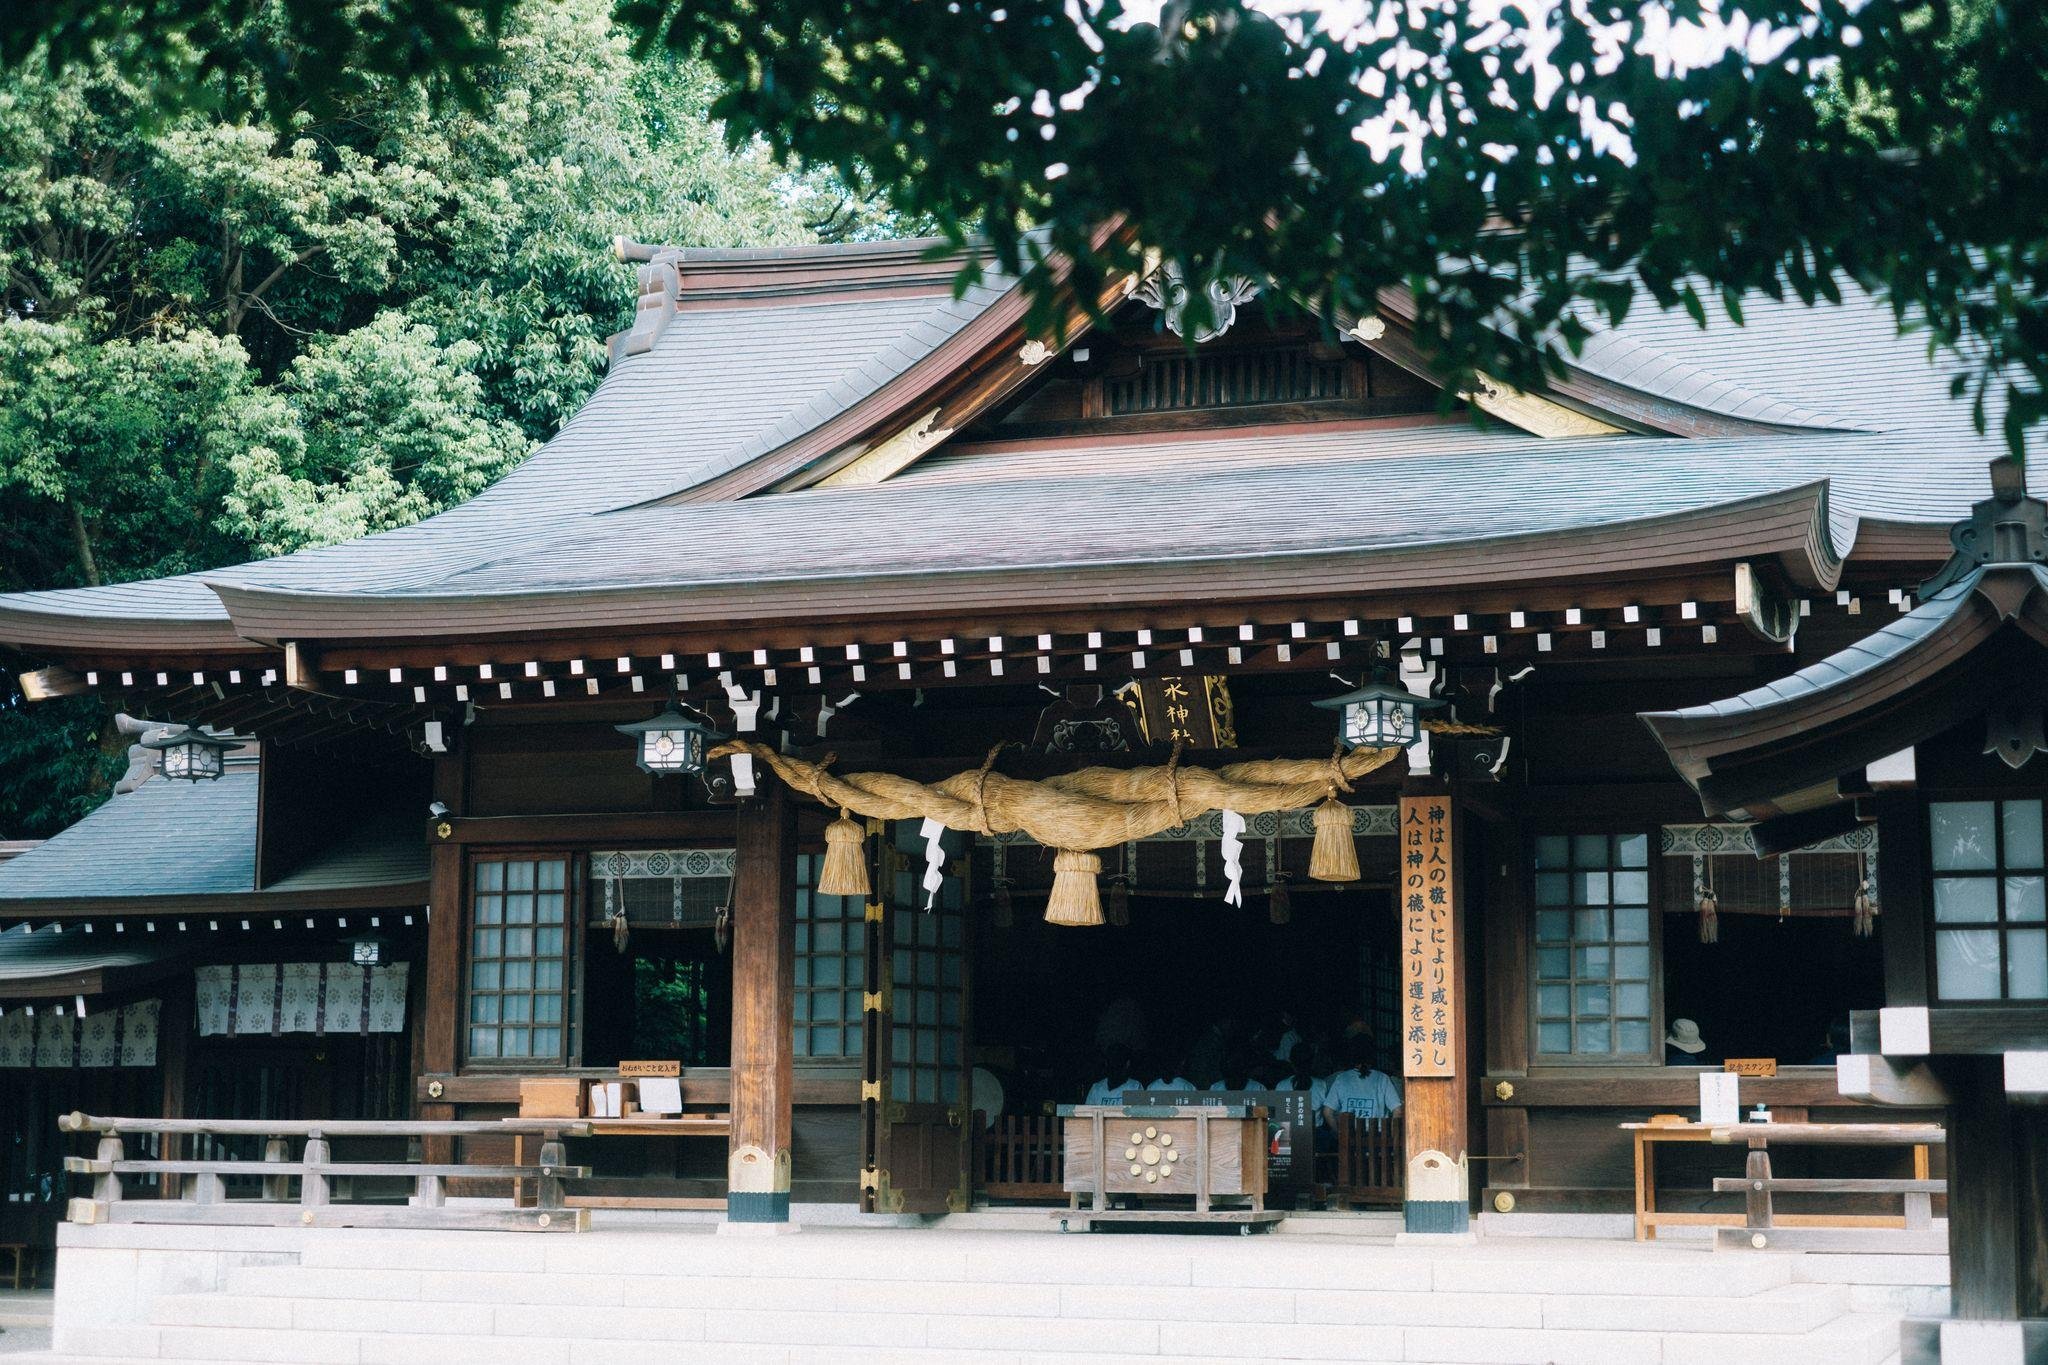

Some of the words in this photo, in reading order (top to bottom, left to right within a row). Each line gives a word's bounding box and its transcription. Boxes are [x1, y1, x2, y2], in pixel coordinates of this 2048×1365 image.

[1161, 676, 1195, 744] 水神社
[1405, 807, 1426, 1066] 人は神の徳により運を添う
[1428, 805, 1448, 1066] 神は人の敬いにより威を増し
[1728, 1063, 1773, 1073] 記念スタンプ
